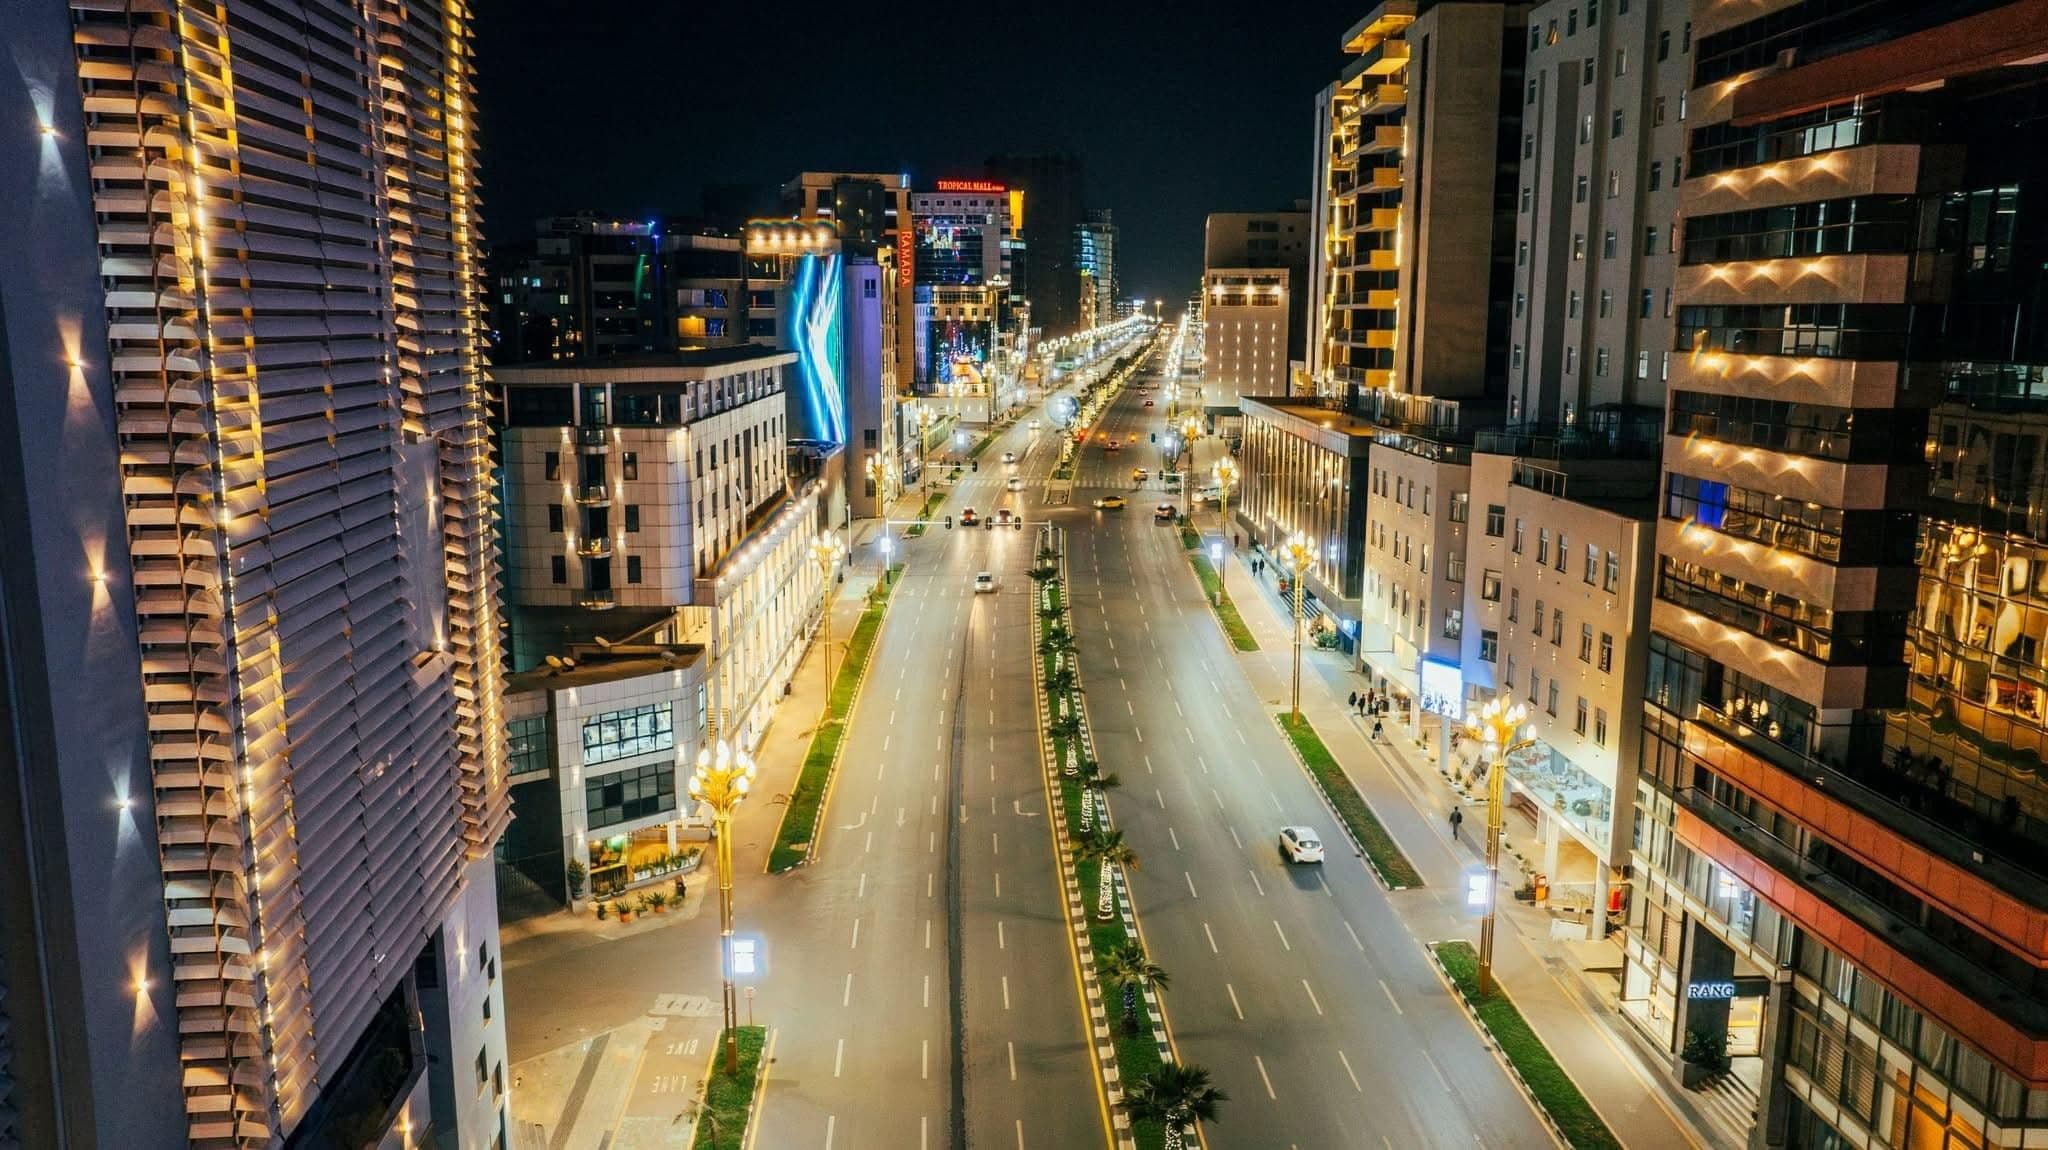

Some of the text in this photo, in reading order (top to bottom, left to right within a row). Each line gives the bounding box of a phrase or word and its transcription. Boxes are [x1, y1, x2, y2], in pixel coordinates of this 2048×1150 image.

[937, 180, 972, 191] TROPICAL
[973, 181, 992, 191] MALL
[901, 231, 914, 286] RAMADA
[1688, 984, 1734, 998] RANG
[665, 1039, 699, 1056] BIKE
[651, 1074, 688, 1094] LANE
